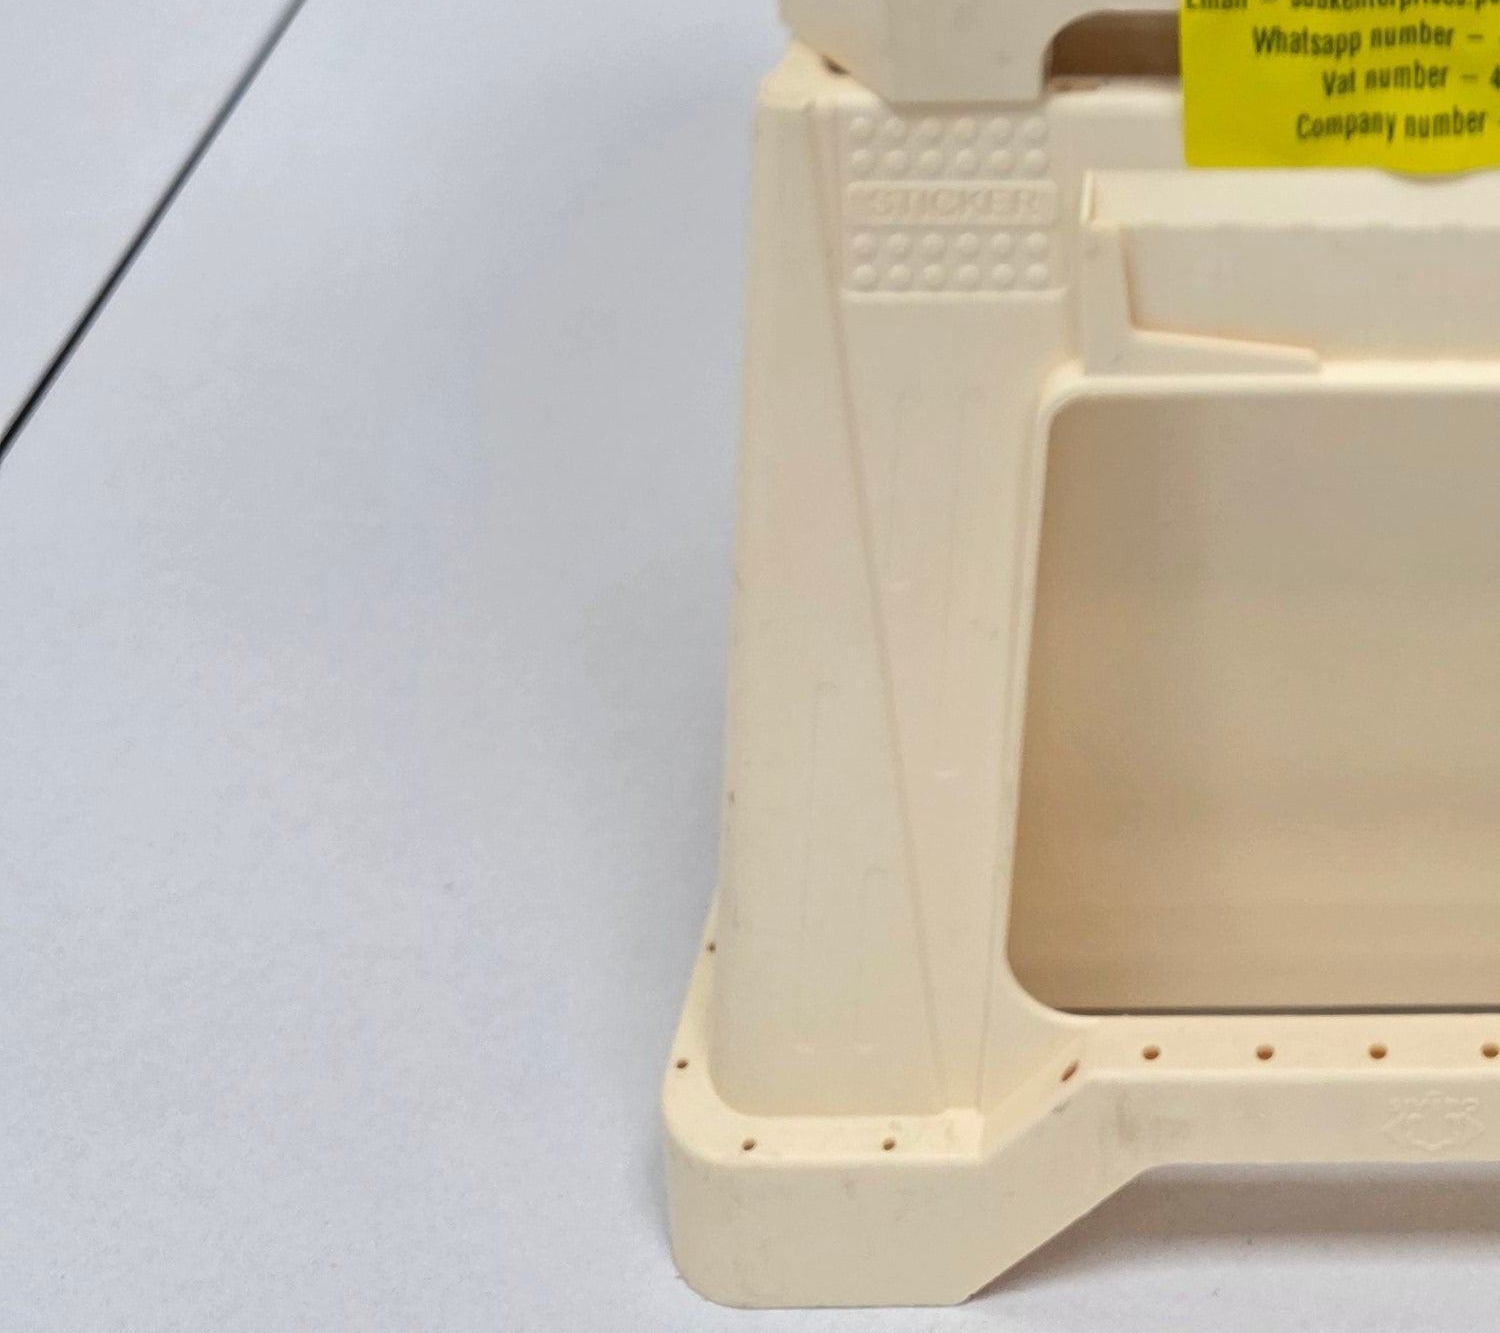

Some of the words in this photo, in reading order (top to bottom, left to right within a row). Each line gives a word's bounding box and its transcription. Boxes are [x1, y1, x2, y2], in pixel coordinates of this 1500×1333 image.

[1252, 25, 1363, 59] Whatsapp
[1370, 19, 1454, 49] number
[1322, 68, 1357, 97] Vat
[1364, 60, 1449, 89] number
[1296, 111, 1397, 142] Company
[1404, 105, 1486, 138] number
